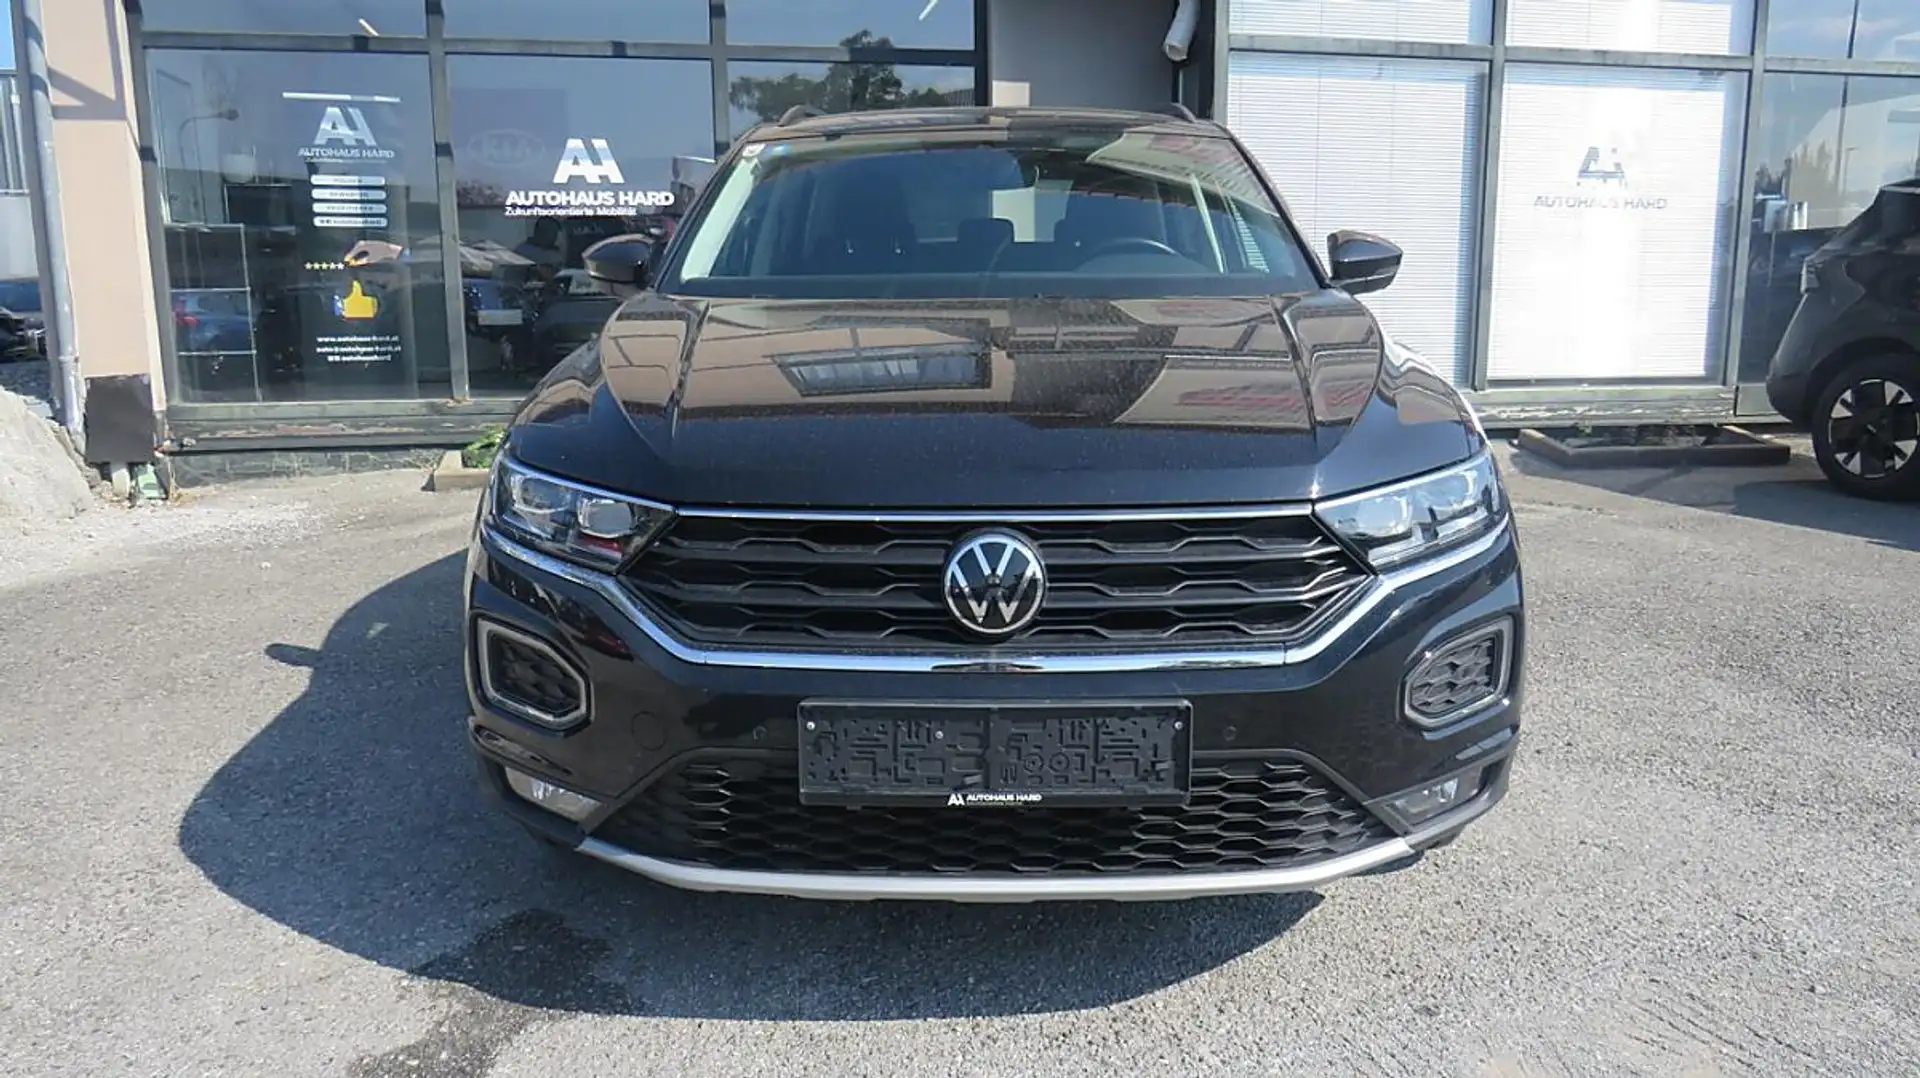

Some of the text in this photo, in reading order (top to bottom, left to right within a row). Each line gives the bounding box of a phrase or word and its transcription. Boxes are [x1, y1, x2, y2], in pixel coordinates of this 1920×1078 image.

[298, 147, 395, 158] AUTOHAUS HARD
[505, 191, 675, 205] AUTOHAUS HARD
[1624, 197, 1668, 210] HARD
[505, 206, 594, 216] Zukunftsorientierte
[966, 793, 1014, 801] AUTOHAUS
[1016, 793, 1042, 801] HARD
